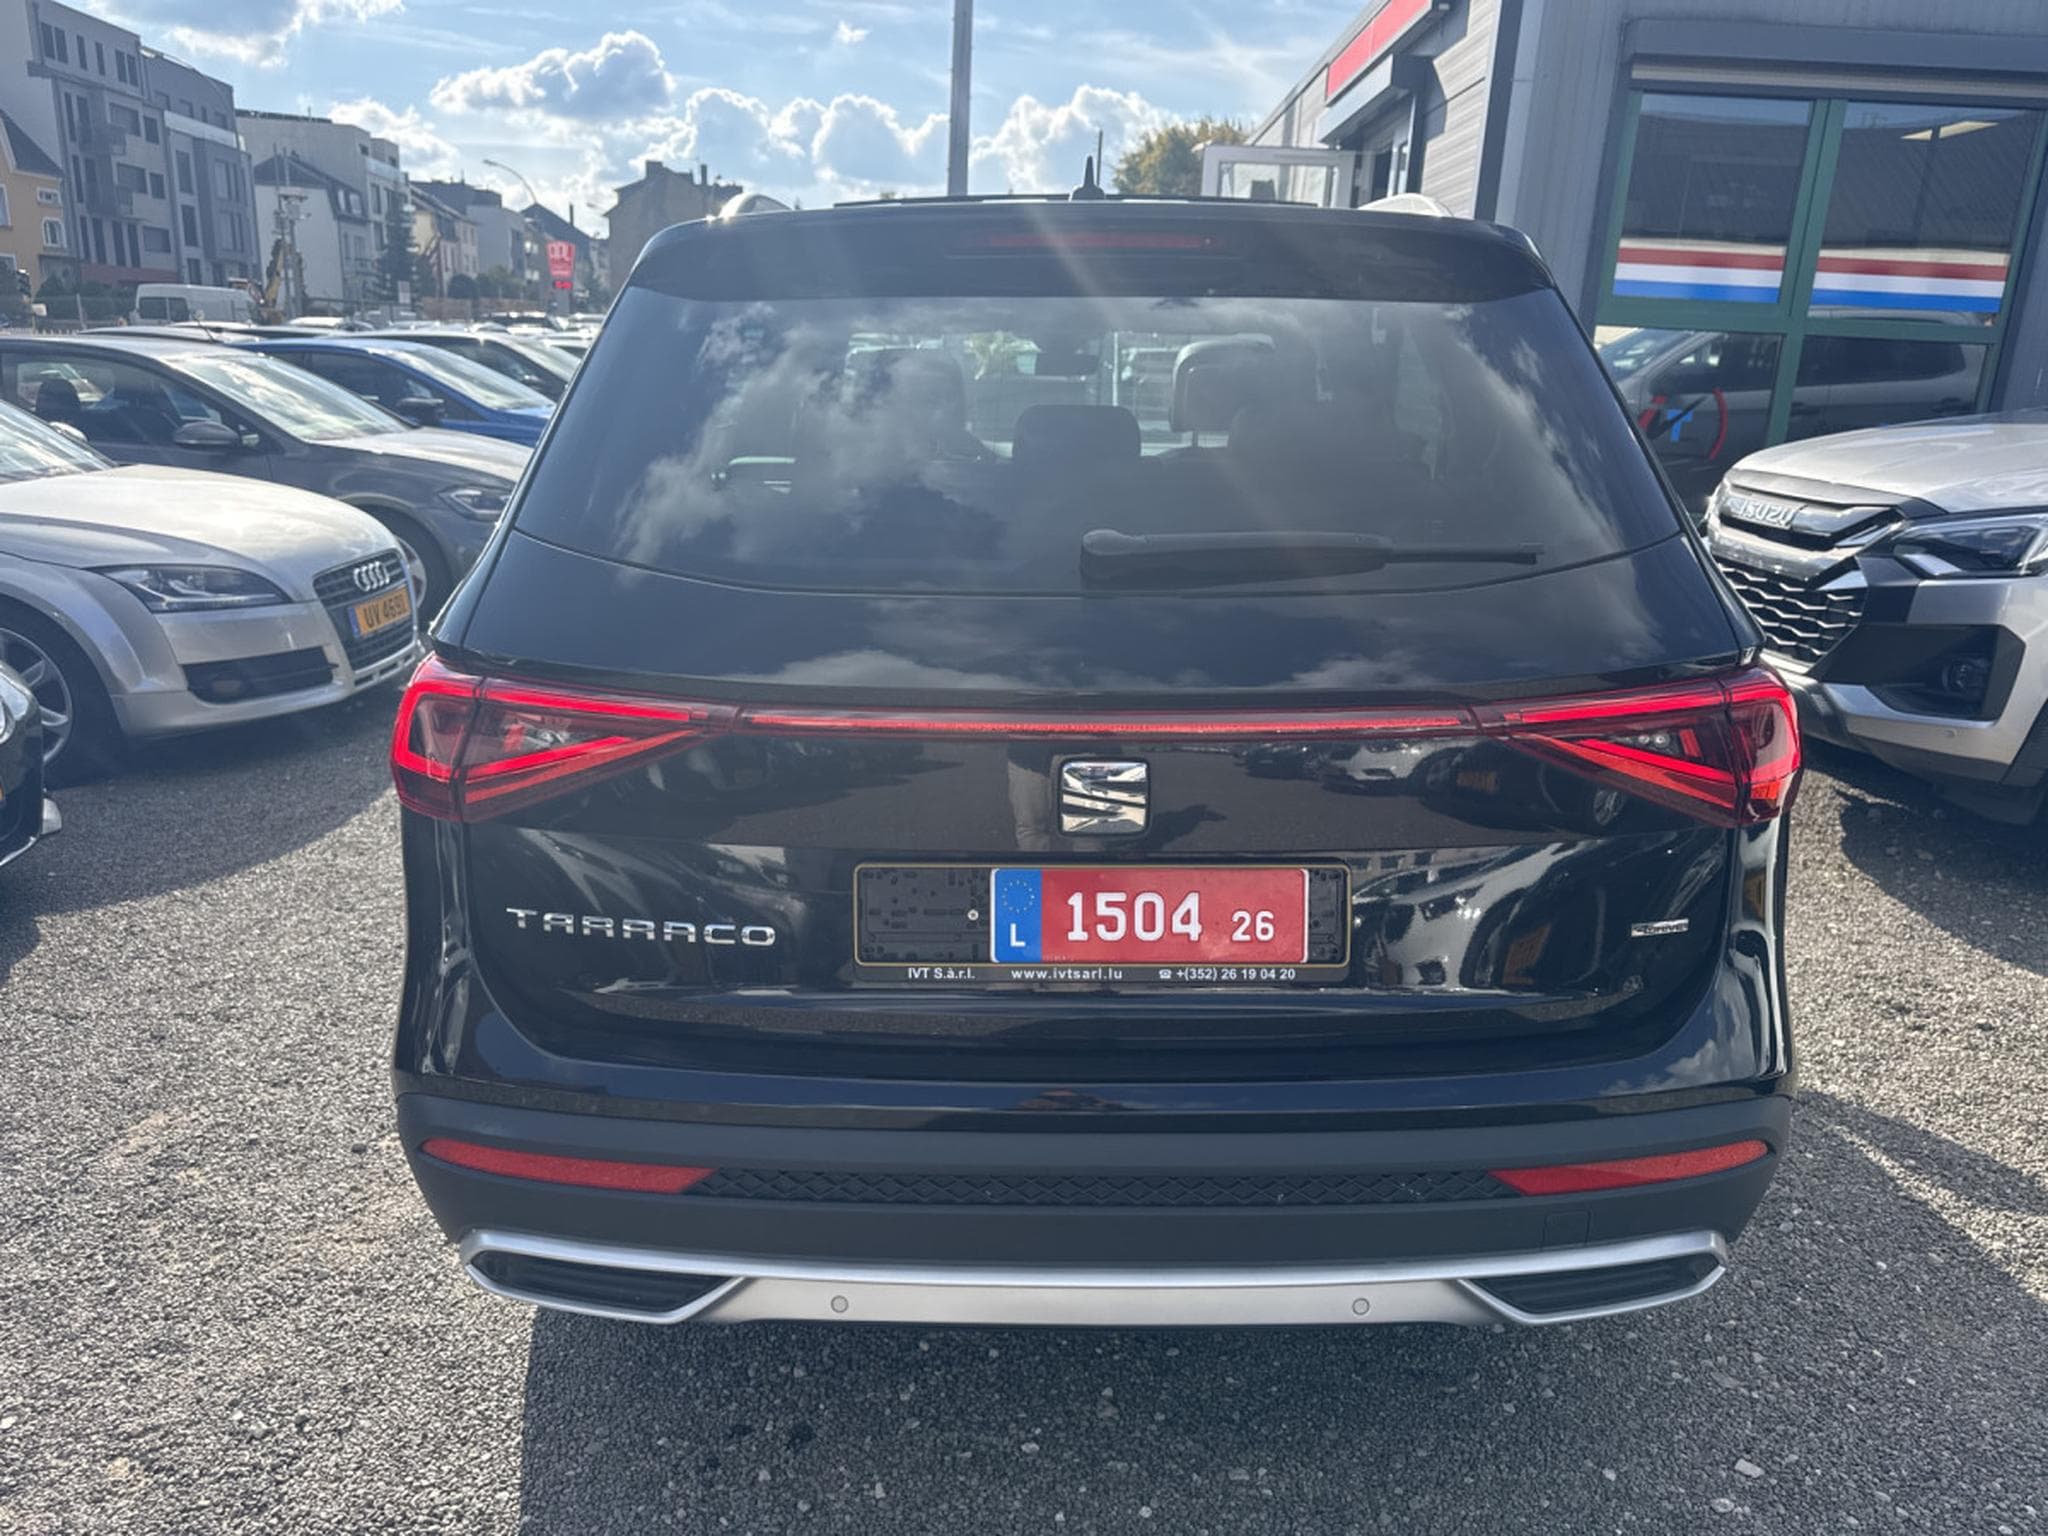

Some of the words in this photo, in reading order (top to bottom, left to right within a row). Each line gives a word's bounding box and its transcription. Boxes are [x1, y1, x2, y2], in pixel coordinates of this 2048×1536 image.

[1740, 500, 1794, 527] ISUZU
[506, 907, 776, 946] TARRACO
[1010, 923, 1026, 947] L
[1067, 892, 1202, 941] 1504
[1231, 910, 1275, 942] 26
[908, 968, 931, 979] IVT
[1011, 967, 1123, 980] www.ivtsarl.lu
[1176, 968, 1218, 981] +(352)
[1221, 968, 1237, 980] 26
[1242, 968, 1257, 980] 19
[1260, 968, 1276, 980] 04
[1279, 968, 1296, 980] 20
